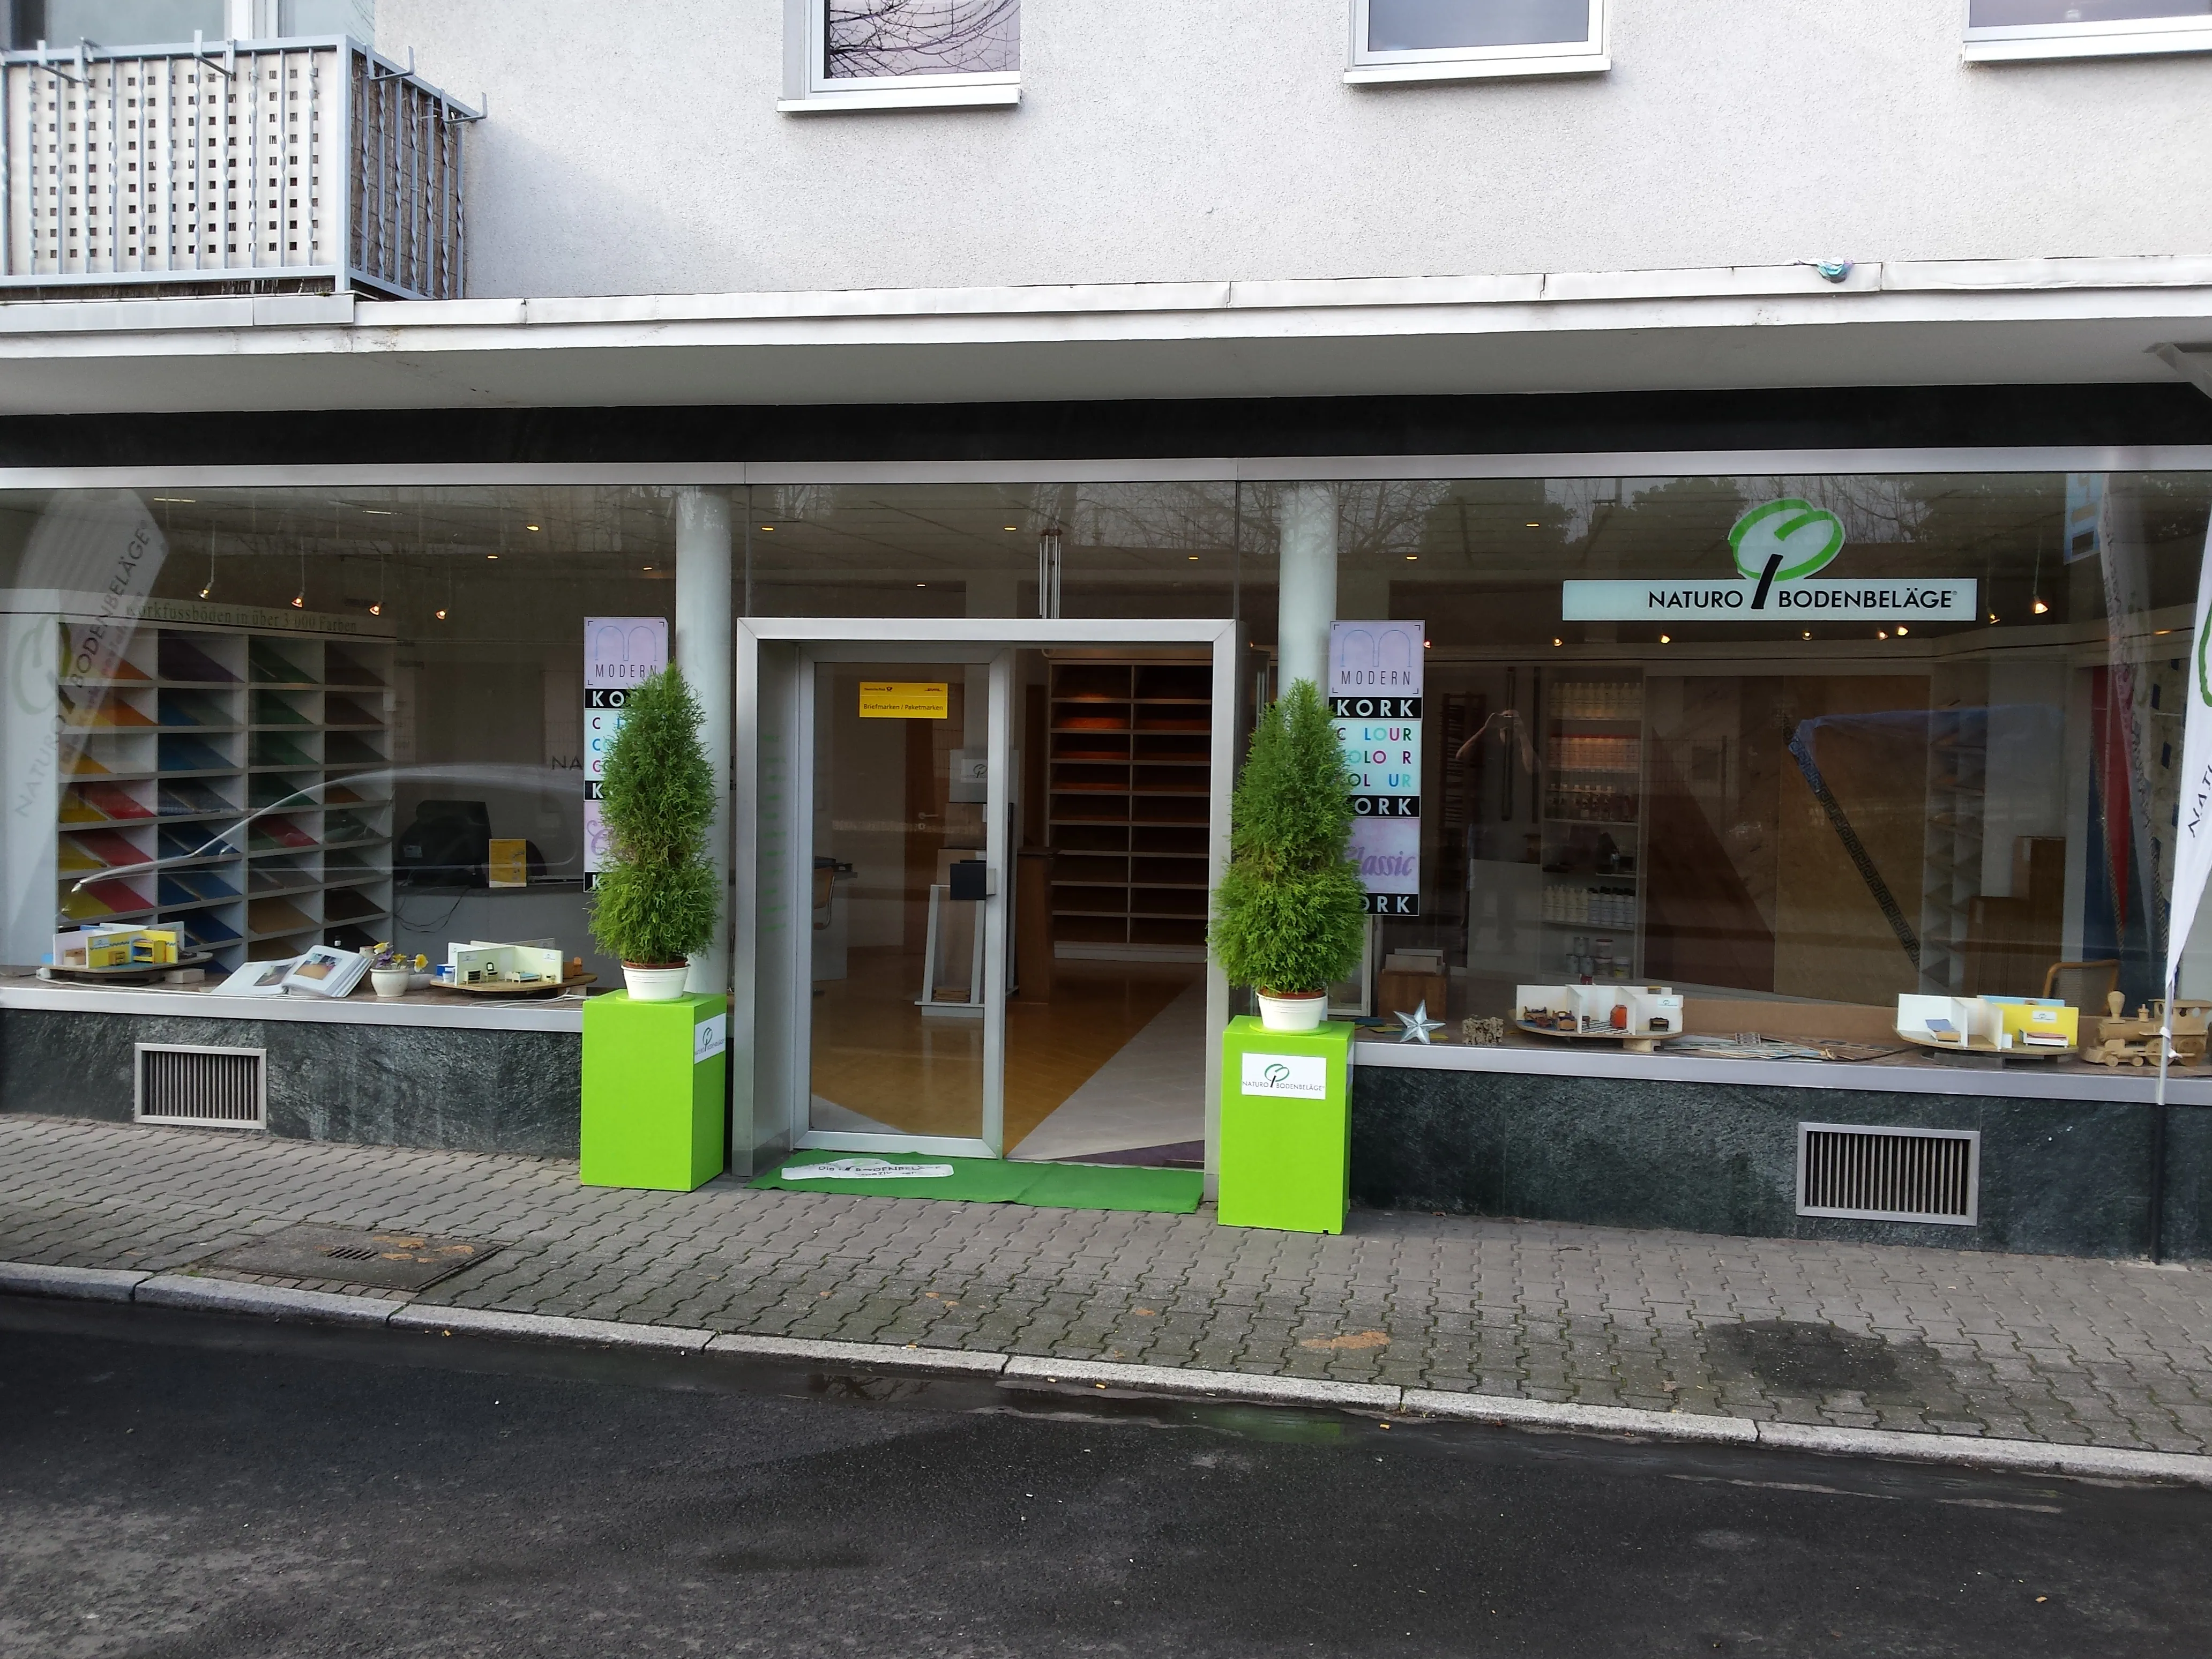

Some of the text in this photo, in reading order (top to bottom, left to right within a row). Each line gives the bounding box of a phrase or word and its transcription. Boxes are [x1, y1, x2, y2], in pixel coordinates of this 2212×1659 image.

[1648, 589, 1743, 608] NATURO
[595, 664, 657, 678] MODERN
[1341, 670, 1410, 685] MODERN
[592, 691, 625, 707] KO
[1337, 699, 1414, 717] KORK
[1354, 797, 1411, 815] ORK
